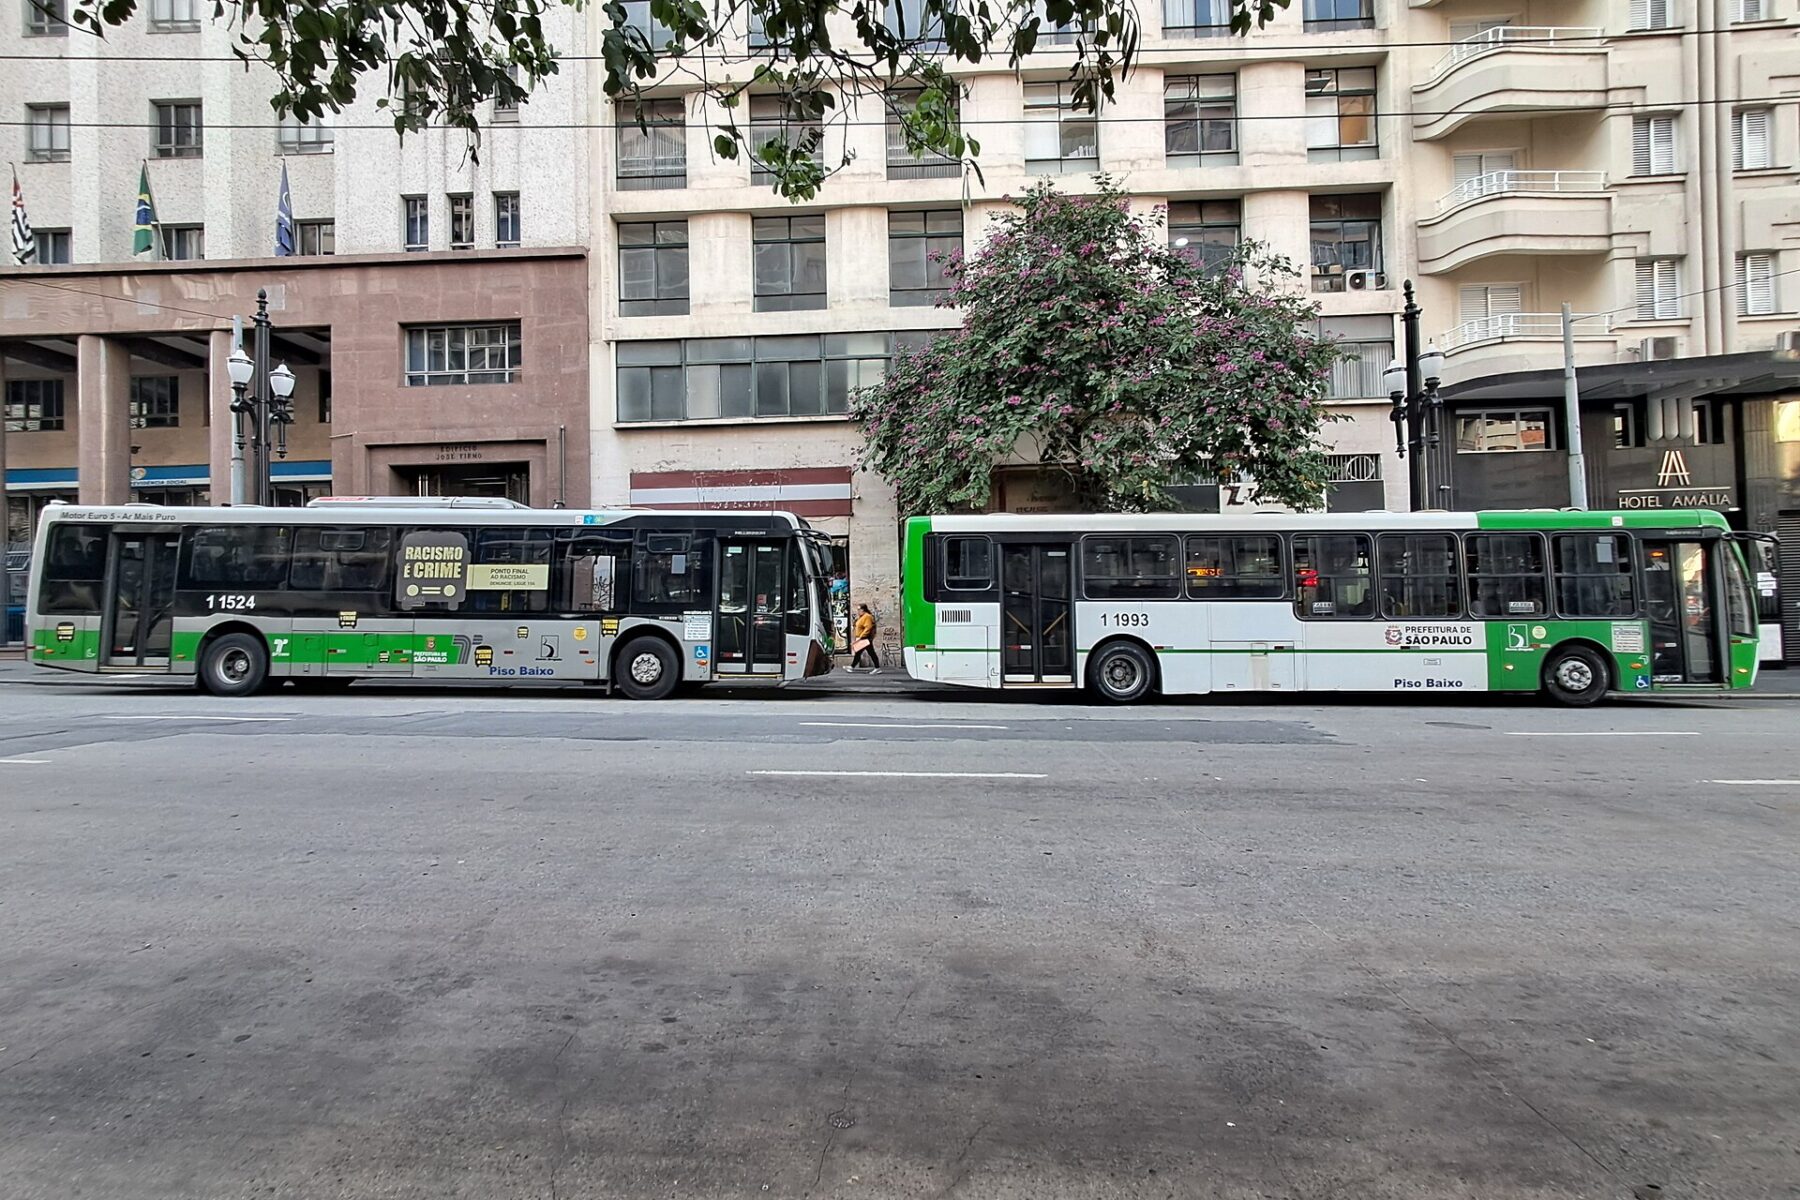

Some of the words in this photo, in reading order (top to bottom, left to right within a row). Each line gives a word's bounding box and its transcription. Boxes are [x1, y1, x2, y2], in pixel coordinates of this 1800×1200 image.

[1618, 496, 1663, 509] HOTEL
[1672, 492, 1731, 507] AMÁLIA
[61, 511, 86, 520] Motor
[87, 511, 108, 520] Euro
[110, 512, 115, 520] 5
[121, 512, 132, 520] Ar
[134, 512, 153, 520] Mais
[155, 513, 176, 521] Puro
[405, 546, 463, 560] RACISMO
[403, 563, 412, 578] É
[413, 562, 462, 578] CRIME
[206, 595, 214, 609] 1
[218, 595, 256, 609] 1524
[1100, 613, 1107, 626] 1
[1113, 613, 1149, 627] 1993
[1405, 625, 1459, 634] PREFEITURA
[1460, 625, 1472, 633] DE
[1405, 634, 1431, 645] SÃO
[1432, 635, 1472, 645] PAULO
[413, 655, 427, 663] SÃO
[489, 666, 516, 676] Piso
[519, 666, 554, 676] Baixo
[1394, 678, 1422, 688] Piso
[1426, 678, 1463, 688] Baixo
